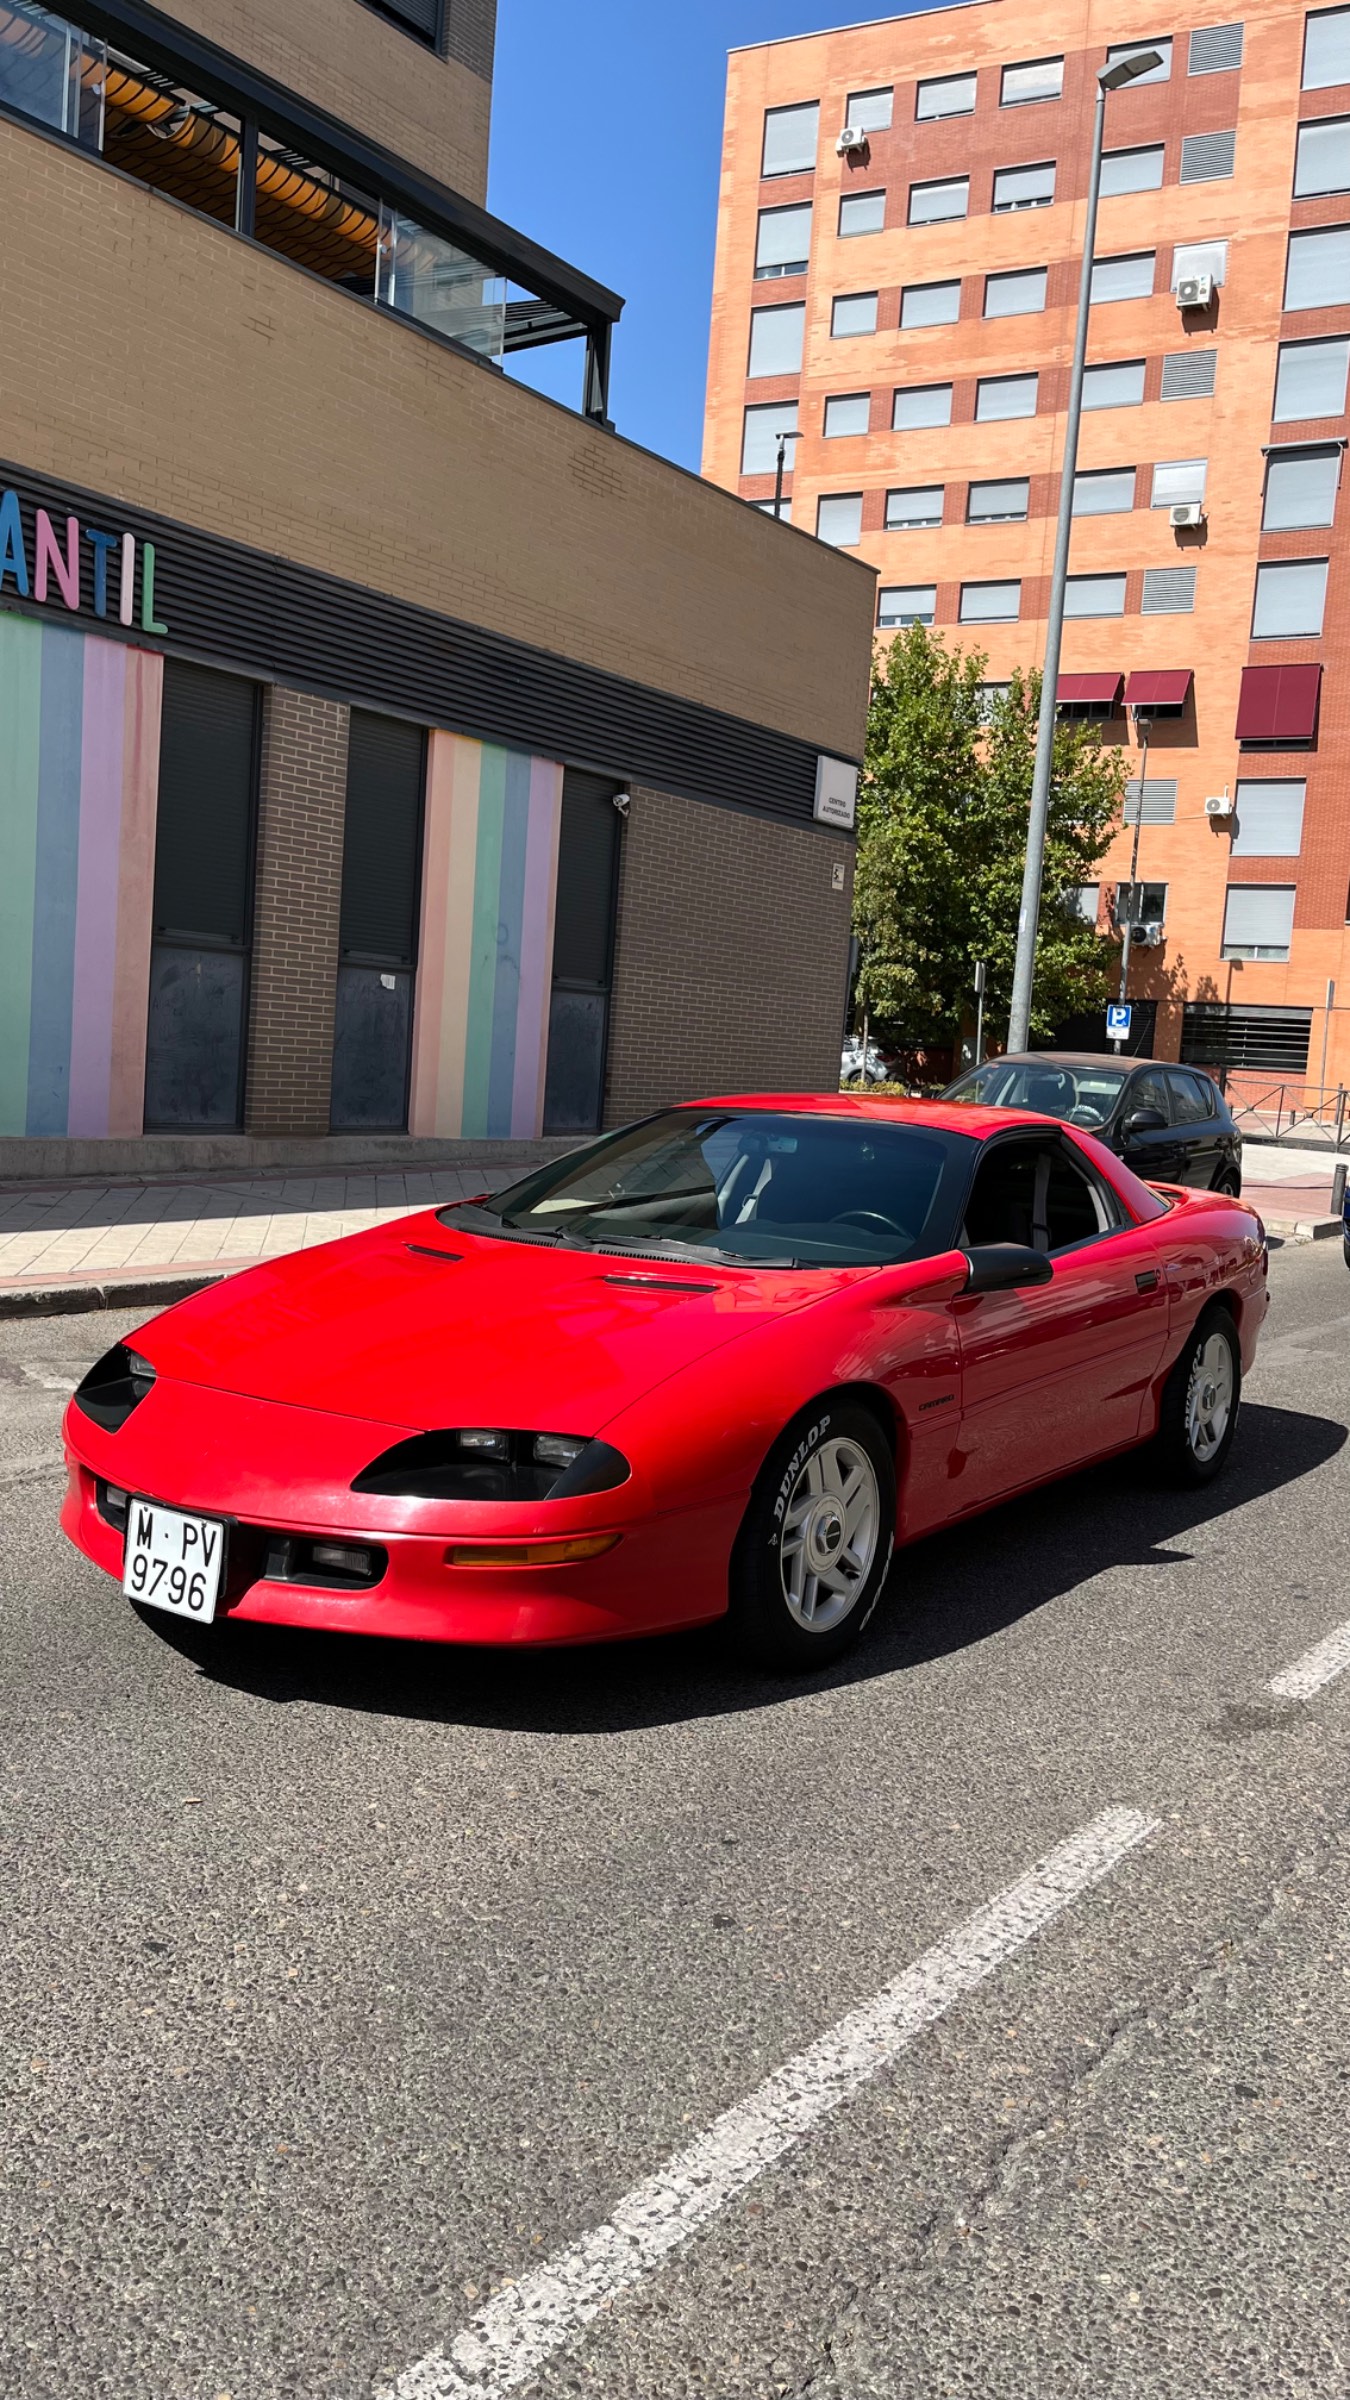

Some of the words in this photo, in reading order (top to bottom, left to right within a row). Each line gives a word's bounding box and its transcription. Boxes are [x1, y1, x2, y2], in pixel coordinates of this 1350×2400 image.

[0, 490, 168, 634] ANTIL
[822, 805, 851, 819] AUTORIZADO
[828, 797, 847, 808] CENTRO
[1111, 1007, 1127, 1026] P
[774, 1415, 831, 1522] DUNLOP
[131, 1554, 207, 1611] 9796
